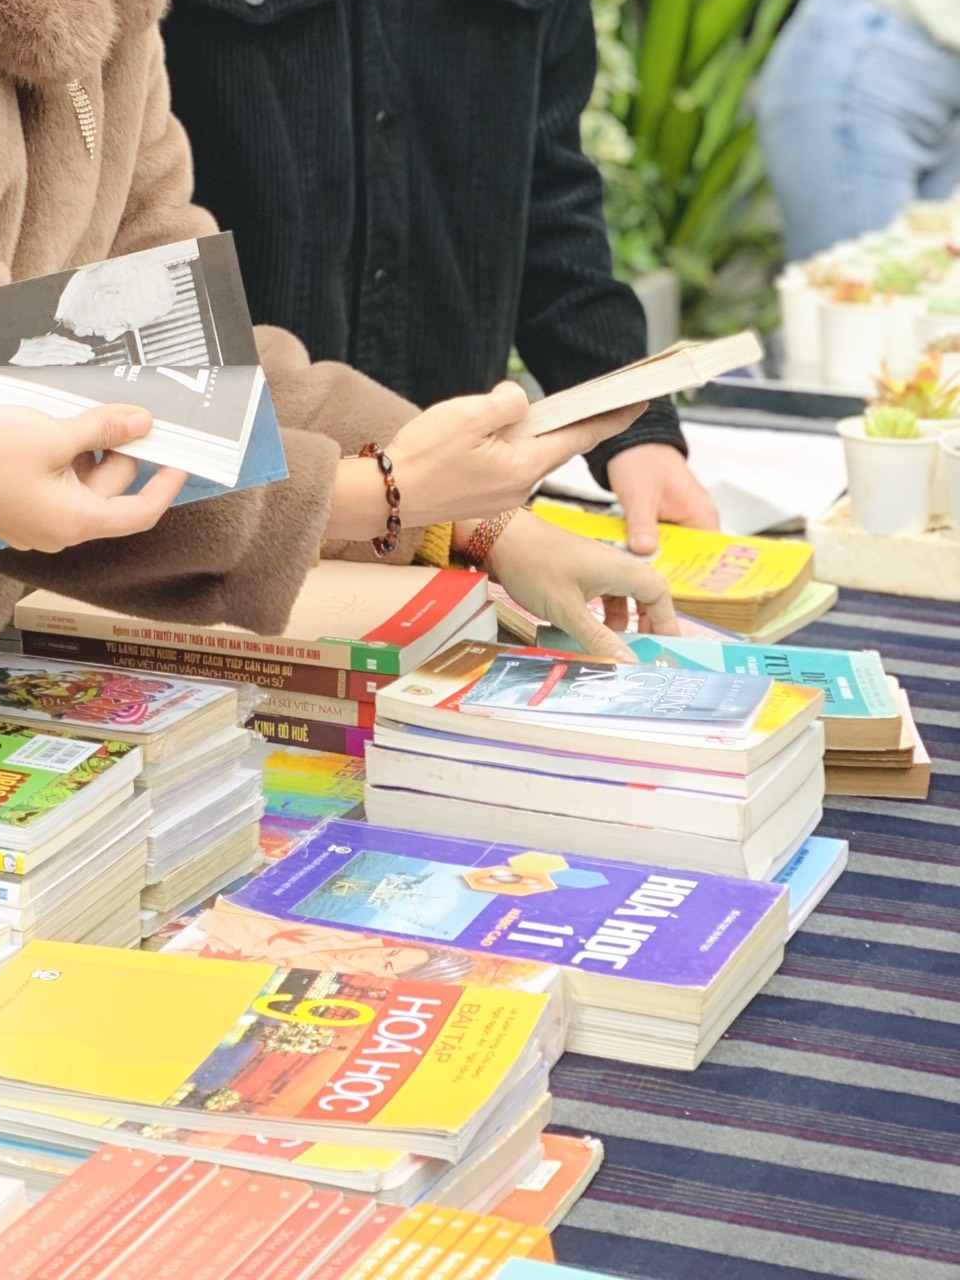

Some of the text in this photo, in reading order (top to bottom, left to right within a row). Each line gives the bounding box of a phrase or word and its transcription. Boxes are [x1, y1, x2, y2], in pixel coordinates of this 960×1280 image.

[156, 366, 210, 394] 7
[173, 631, 187, 644] PHÁT
[229, 639, 241, 650] NAM
[243, 640, 261, 653] TRONG
[306, 648, 321, 660] MINH
[203, 652, 224, 667] CÁCH
[262, 661, 280, 675] LỊCH
[292, 699, 316, 712] VIỆT
[319, 704, 342, 716] NAM
[254, 719, 275, 737] KINH
[291, 723, 309, 742] HUẾ
[507, 920, 575, 949] 11
[571, 874, 699, 971] HOÁ HỌC
[480, 929, 502, 947] CAO
[252, 993, 376, 1027] 9
[434, 1003, 481, 1063] BÀI TẬP
[318, 995, 441, 1113] HOÁ HỌC
